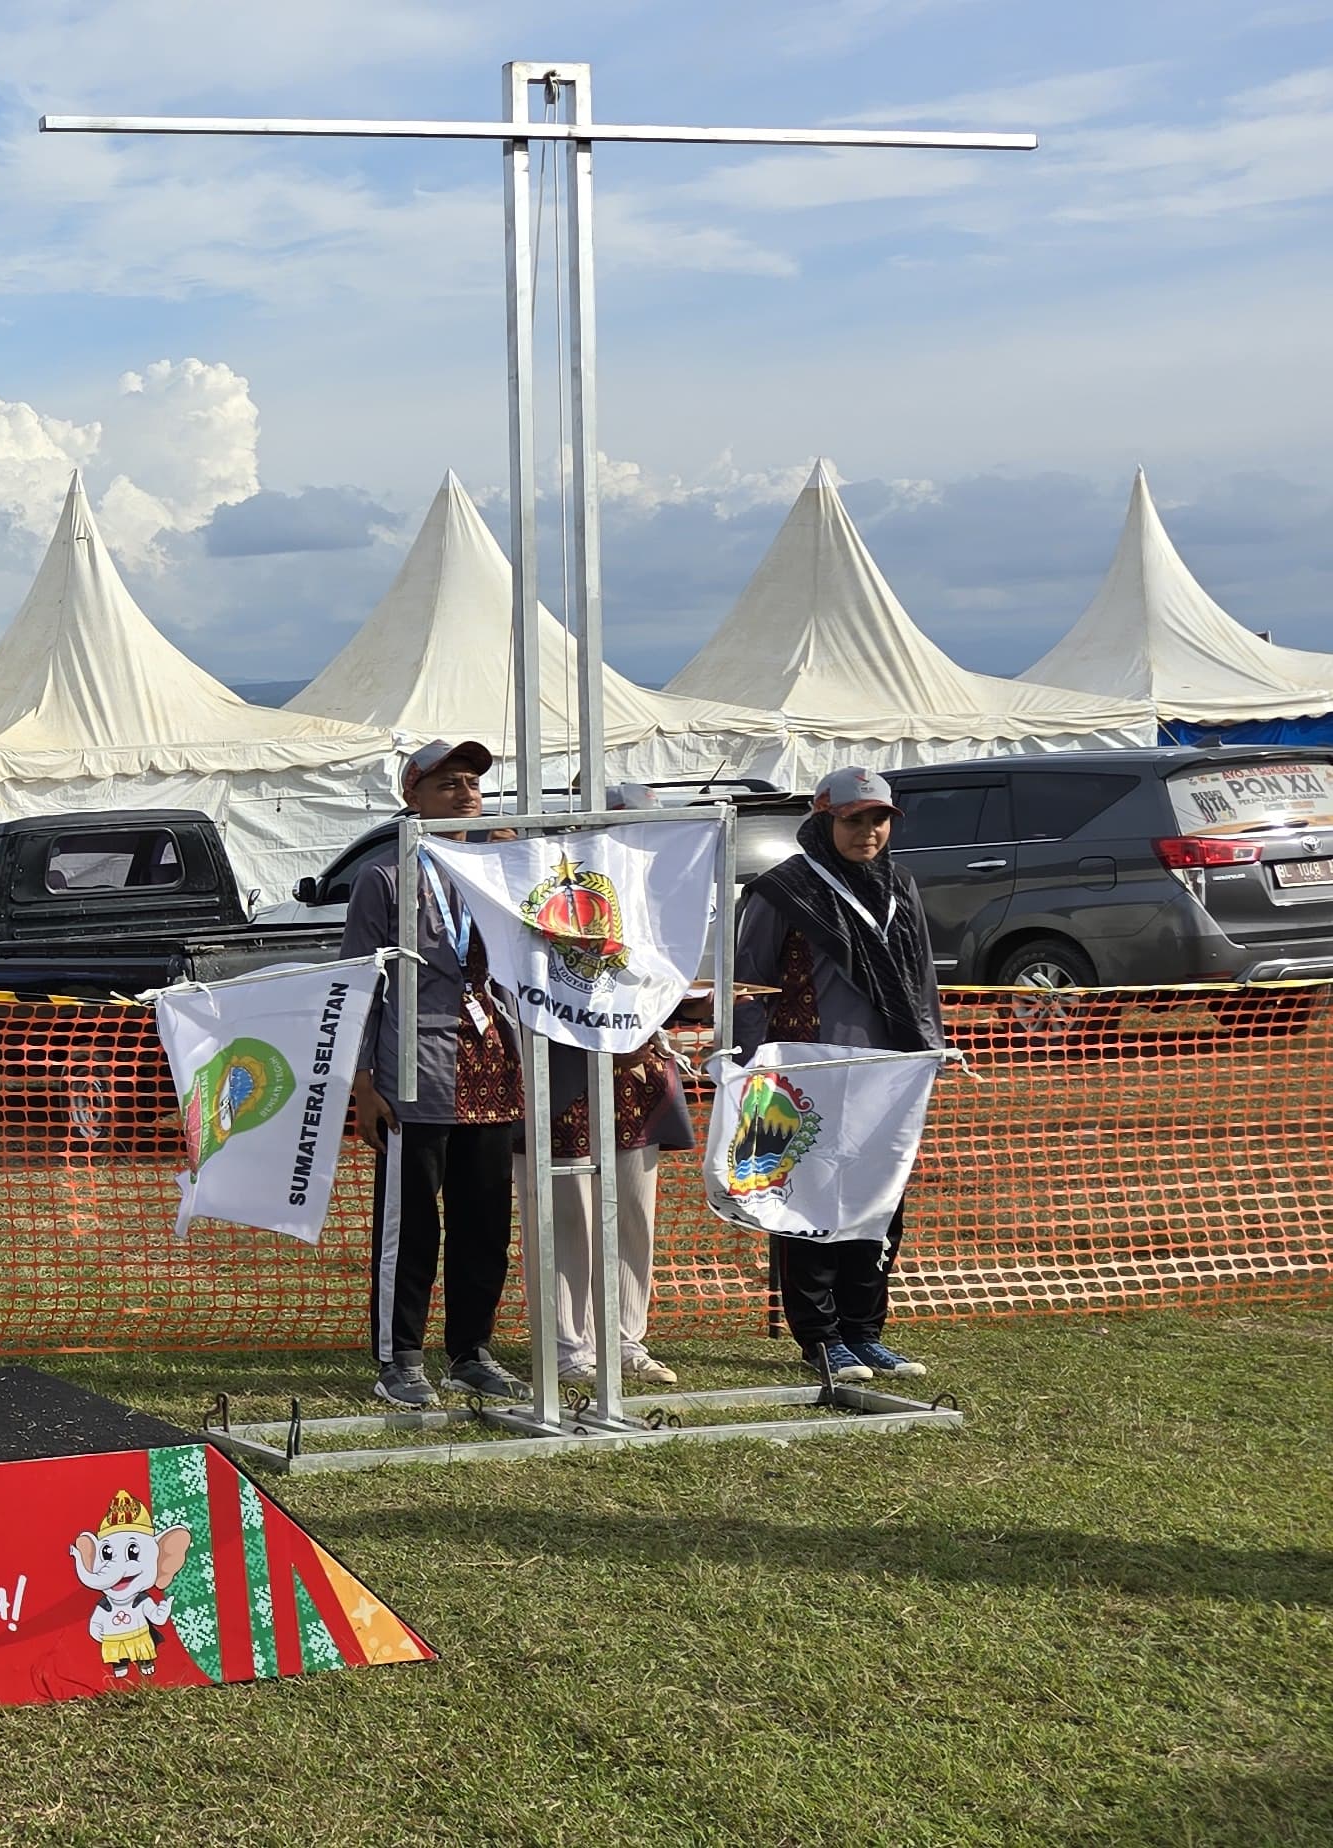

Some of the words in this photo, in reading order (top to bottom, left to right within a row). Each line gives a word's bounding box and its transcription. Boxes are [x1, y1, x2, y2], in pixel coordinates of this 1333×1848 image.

[1226, 776, 1285, 799] PON
[1284, 774, 1325, 793] XXI
[289, 1081, 328, 1206] SUMATERA
[313, 982, 350, 1076] SELATAN
